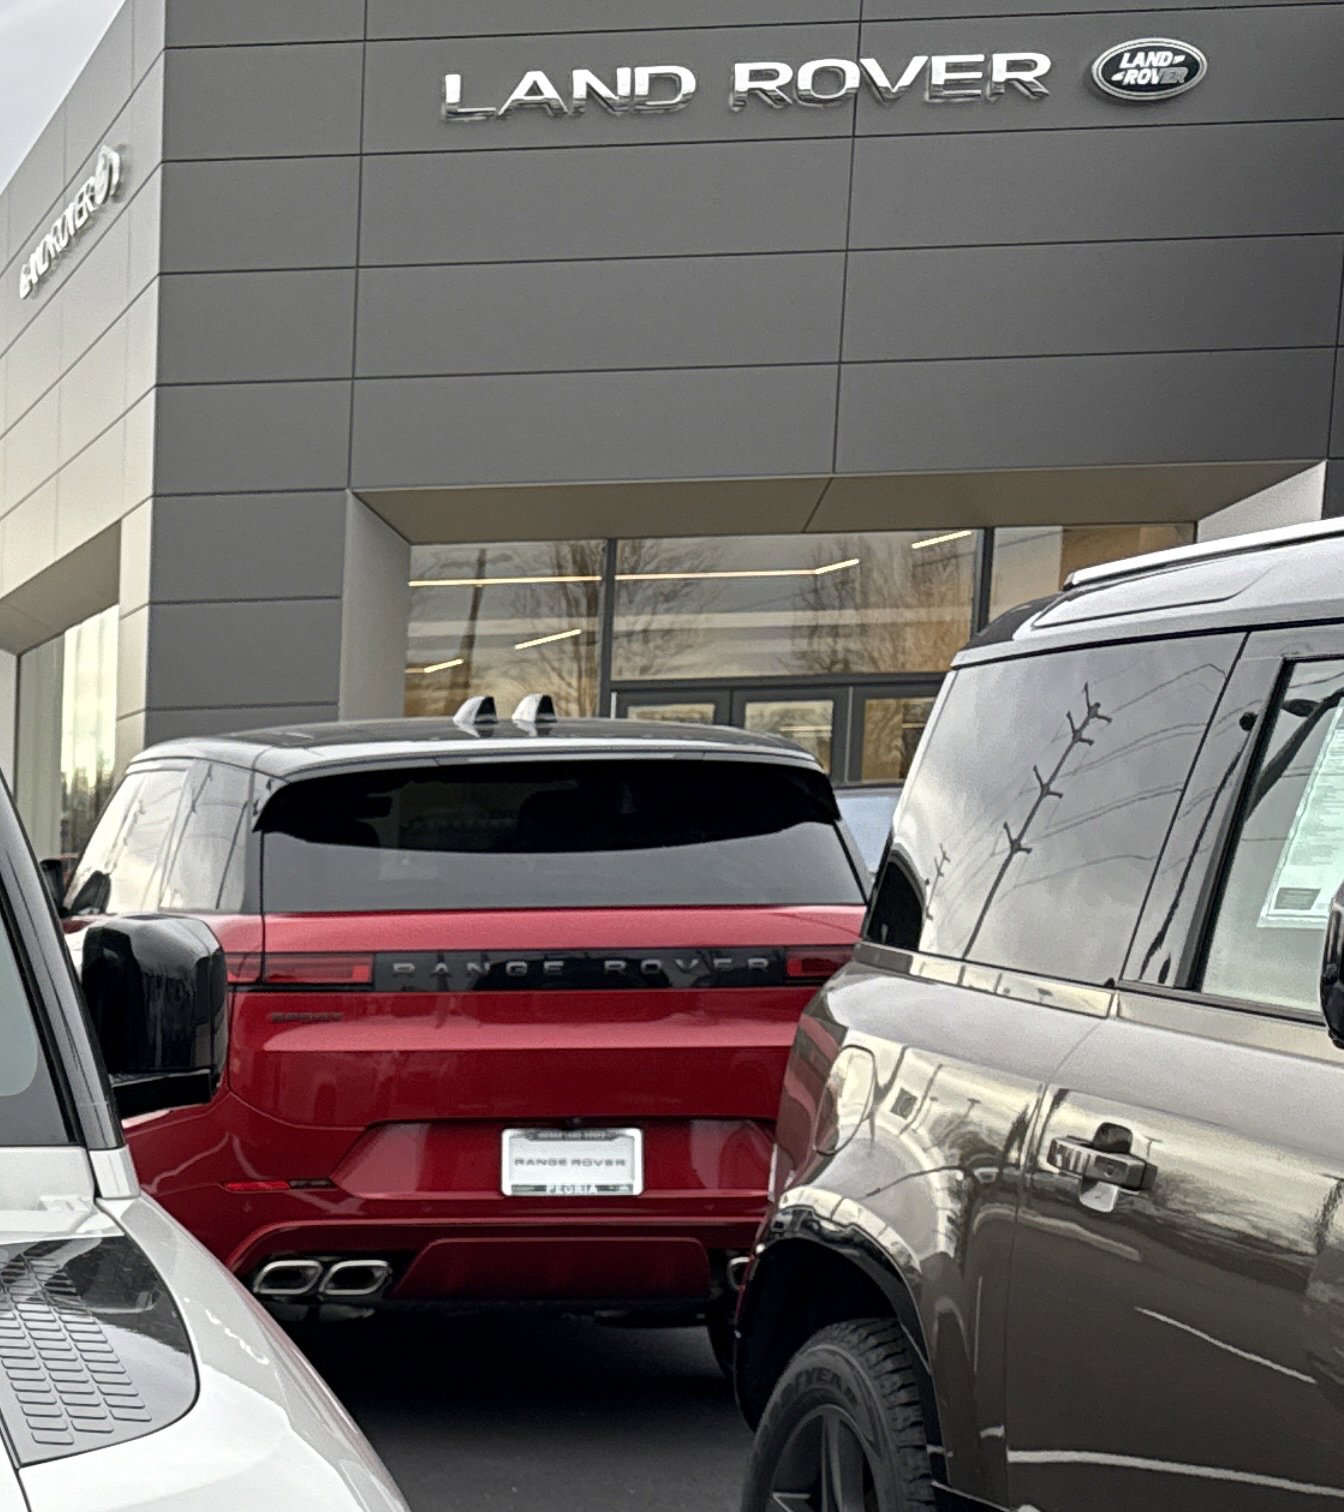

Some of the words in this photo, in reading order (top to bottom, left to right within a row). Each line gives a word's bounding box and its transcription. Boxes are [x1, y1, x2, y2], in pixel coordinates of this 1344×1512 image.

[1119, 51, 1174, 69] LAND
[1122, 66, 1189, 85] ROVER
[443, 65, 697, 121] LAND
[729, 52, 1051, 112] ROVER
[391, 959, 565, 977] RANGE
[603, 957, 770, 976] ROVER
[514, 1158, 568, 1167] RANGE
[571, 1158, 626, 1167] ROVER
